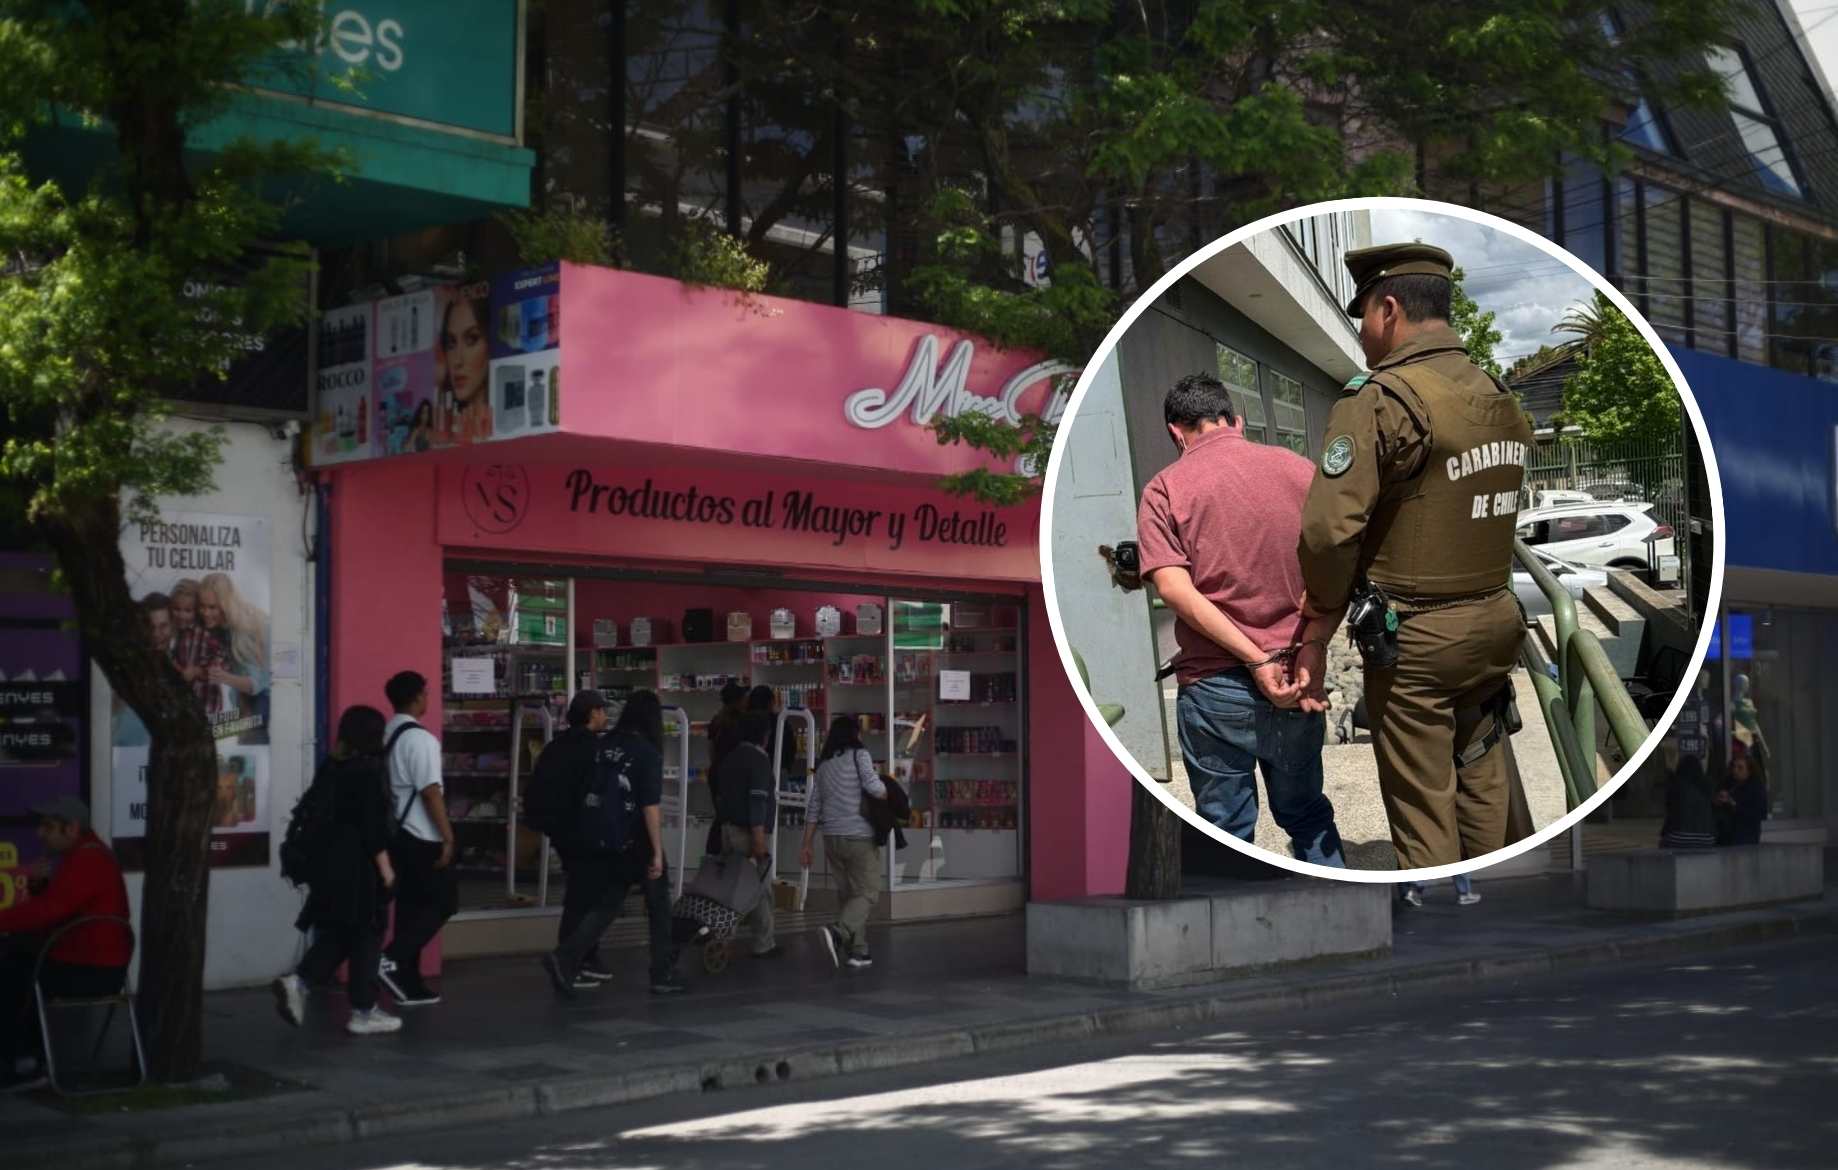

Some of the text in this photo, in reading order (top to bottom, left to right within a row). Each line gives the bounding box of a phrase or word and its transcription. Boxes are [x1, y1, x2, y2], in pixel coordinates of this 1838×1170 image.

[1446, 440, 1525, 481] CARABINER
[565, 468, 1008, 550] Productos al Mayor y Detalle
[1471, 494, 1489, 519] DE
[140, 521, 241, 548] PERSONALIZA
[147, 547, 235, 571] TU CELULAR
